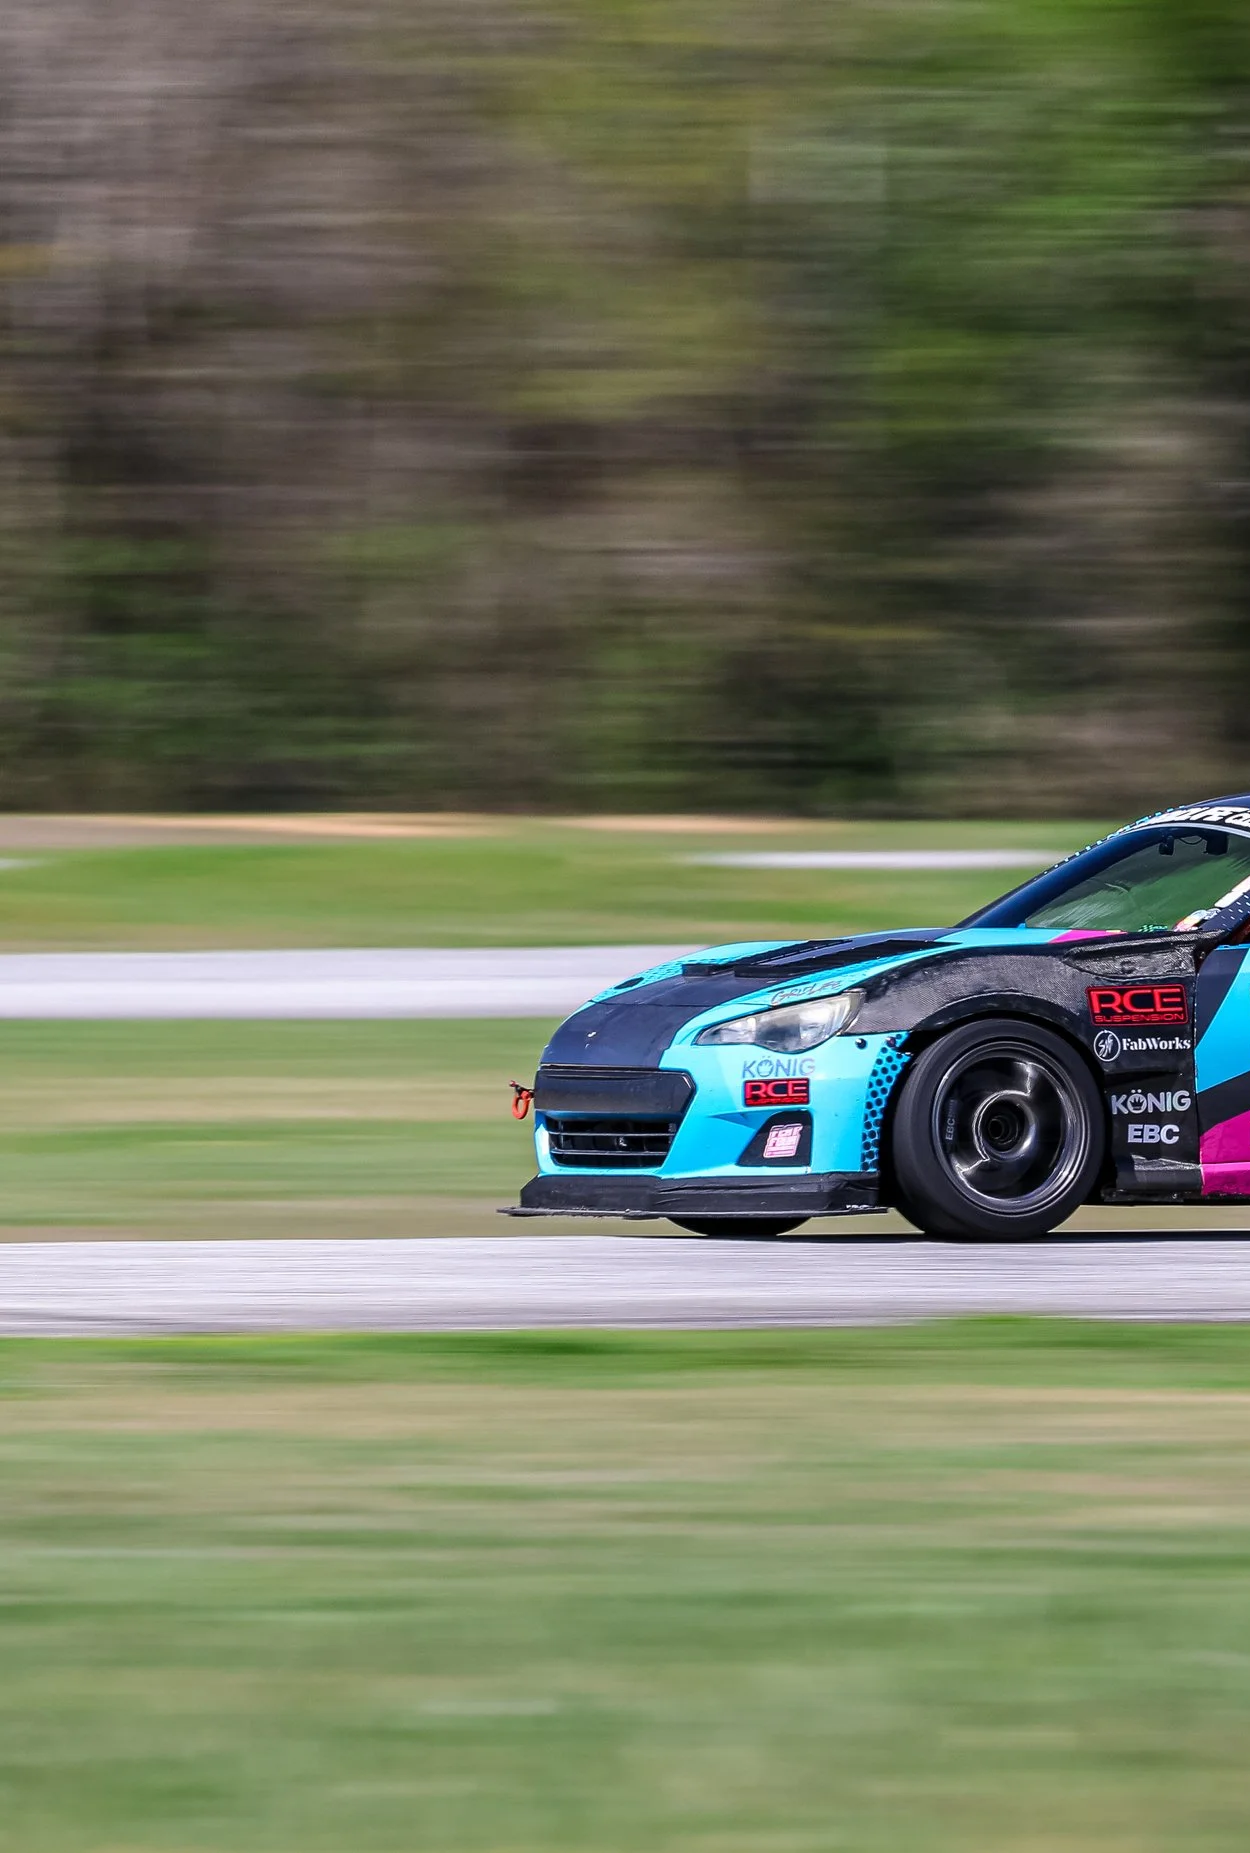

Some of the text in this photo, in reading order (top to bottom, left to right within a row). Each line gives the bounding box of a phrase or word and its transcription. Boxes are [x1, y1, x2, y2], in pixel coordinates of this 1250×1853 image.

[1090, 988, 1183, 1014] RCE
[1094, 1013, 1185, 1023] SUSPENSION
[1122, 1036, 1192, 1051] FabWorks
[745, 1080, 808, 1098] RCE
[1127, 1123, 1180, 1145] EBC
